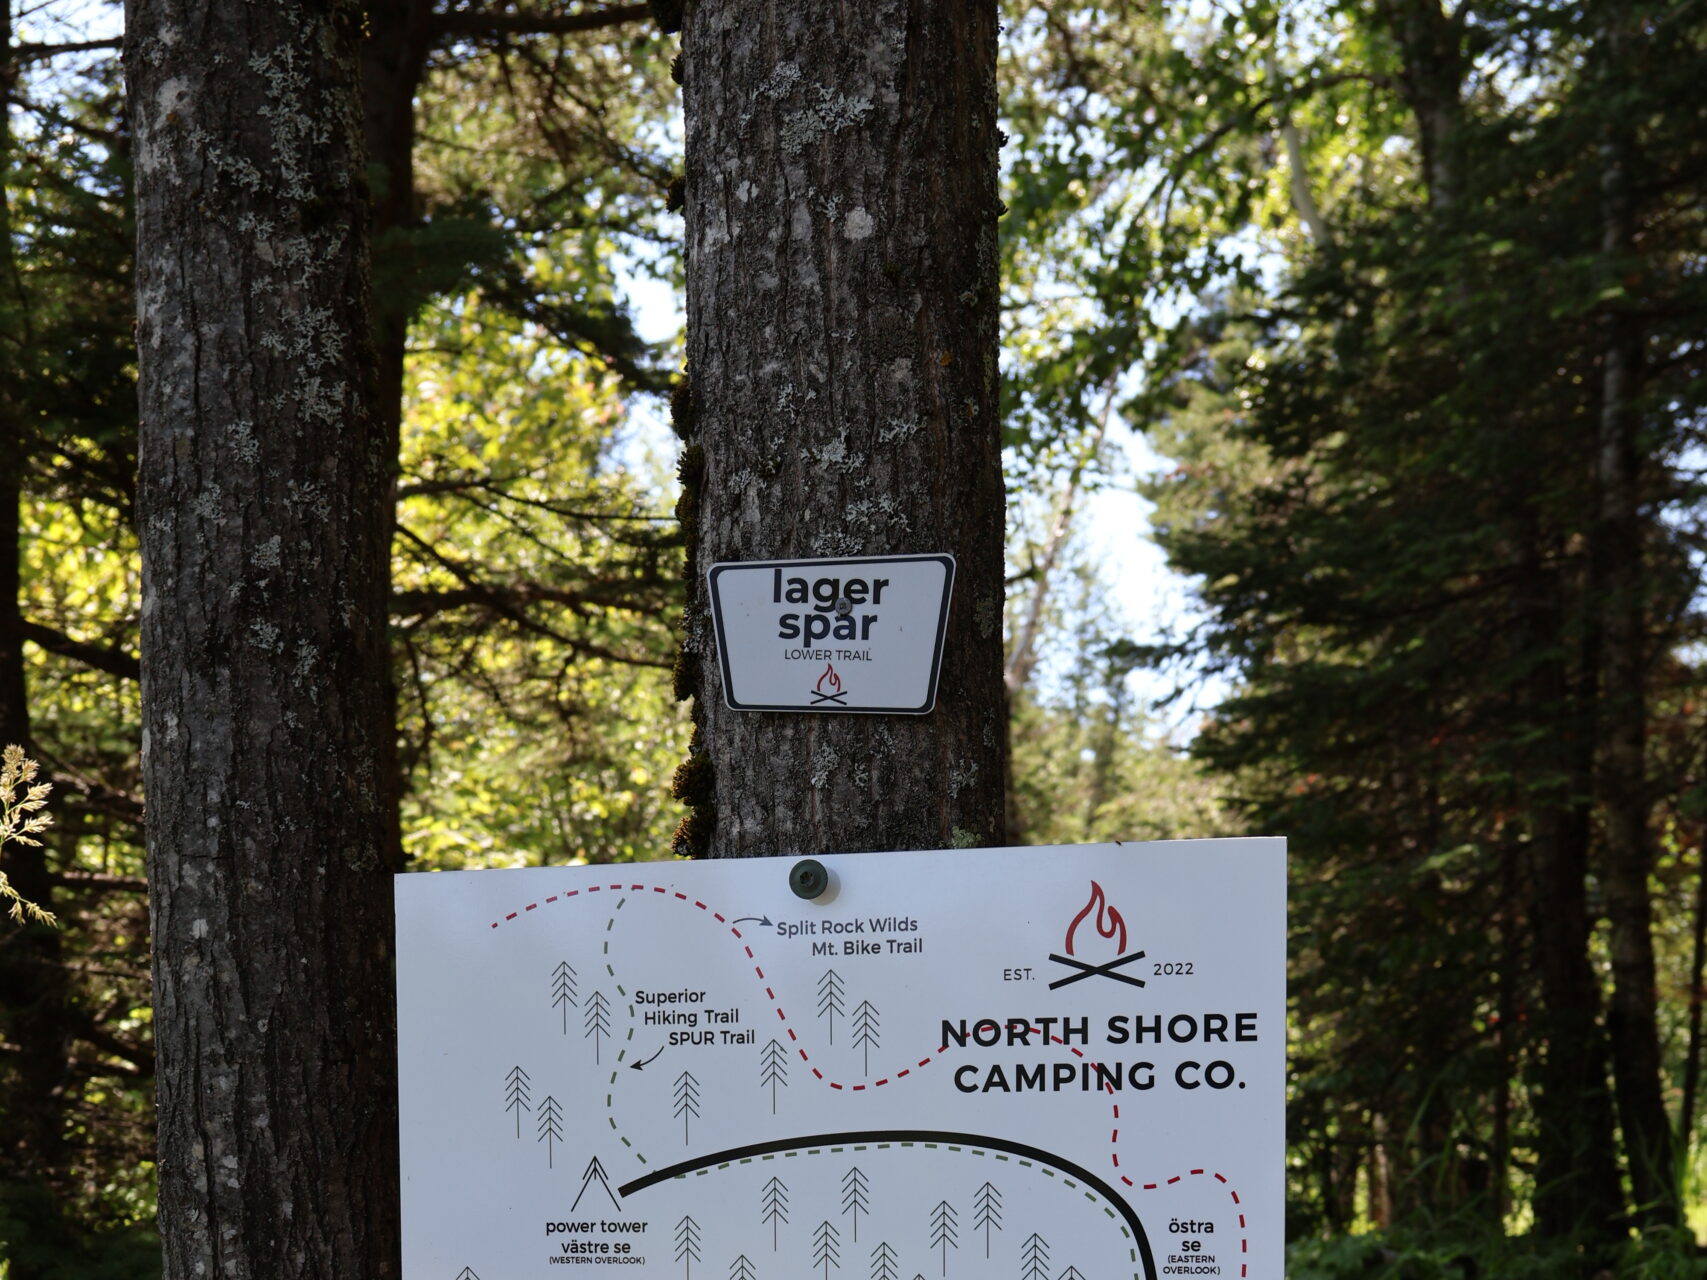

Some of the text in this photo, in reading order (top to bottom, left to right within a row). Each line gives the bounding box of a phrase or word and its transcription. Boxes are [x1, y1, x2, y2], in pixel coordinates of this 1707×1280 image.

[772, 568, 889, 613] lager
[785, 649, 872, 661] LOWER TRAIL
[777, 916, 918, 938] Split Rock Wilds
[812, 938, 923, 956] Mt. Bike Trail
[1003, 968, 1035, 981] EST.
[1153, 962, 1194, 976] 2022
[635, 989, 706, 1007] Superior
[644, 1008, 739, 1027] Hiking Trail
[669, 1030, 755, 1046] SPUR Trail
[941, 1013, 1259, 1049] NORTH SHORE
[954, 1060, 1246, 1093] CAMPING CO.
[546, 1219, 648, 1237] power tower
[1168, 1218, 1215, 1235] östra
[562, 1240, 631, 1254] västre se
[1182, 1238, 1202, 1252] se
[549, 1255, 645, 1266] (WESTERN OVERLOOK)
[1167, 1254, 1215, 1265] (EASTERN
[1162, 1265, 1221, 1276] OVERLOOK)
